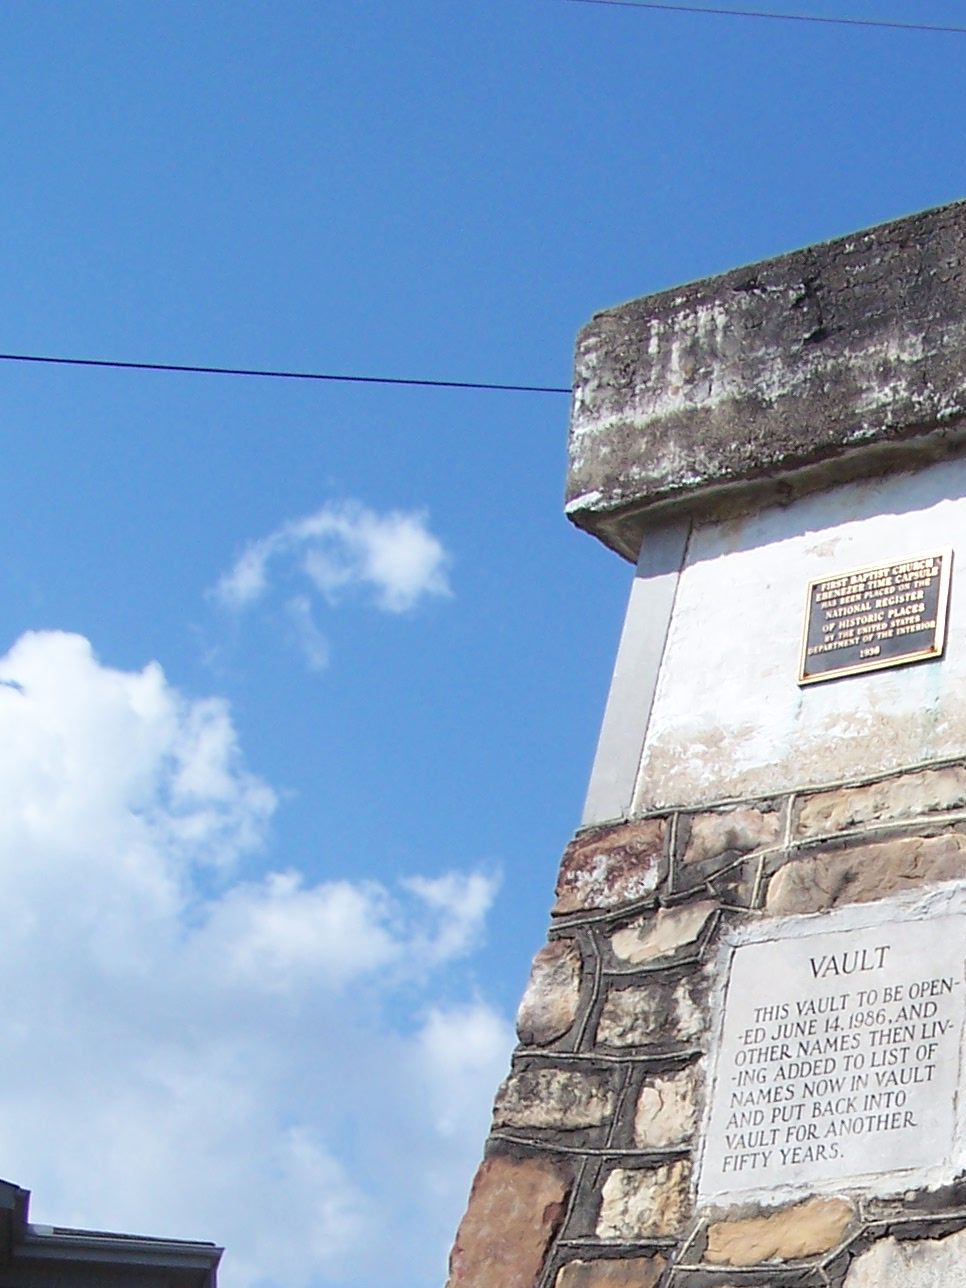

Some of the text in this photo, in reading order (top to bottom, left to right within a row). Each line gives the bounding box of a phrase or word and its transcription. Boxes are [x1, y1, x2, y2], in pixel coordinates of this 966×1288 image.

[810, 945, 890, 978] VAULT
[753, 977, 960, 1023] THIS VAULT TO BE OPEN-
[771, 1020, 817, 1041] JUNE
[895, 1001, 938, 1021] AND
[734, 1020, 955, 1066] OTHER NAMES THEN LIV-
[774, 1058, 836, 1082] ADDED
[843, 1054, 865, 1071] TO
[871, 1048, 910, 1068] LIST
[916, 1043, 939, 1062] OF
[730, 1065, 936, 1109] NAMES NOW IN VAULT
[726, 1090, 907, 1129] AND PUT BACK INTO
[724, 1110, 918, 1150] VAULT FOR ANOTHER
[722, 1142, 844, 1172] FIFTY YEARS.
